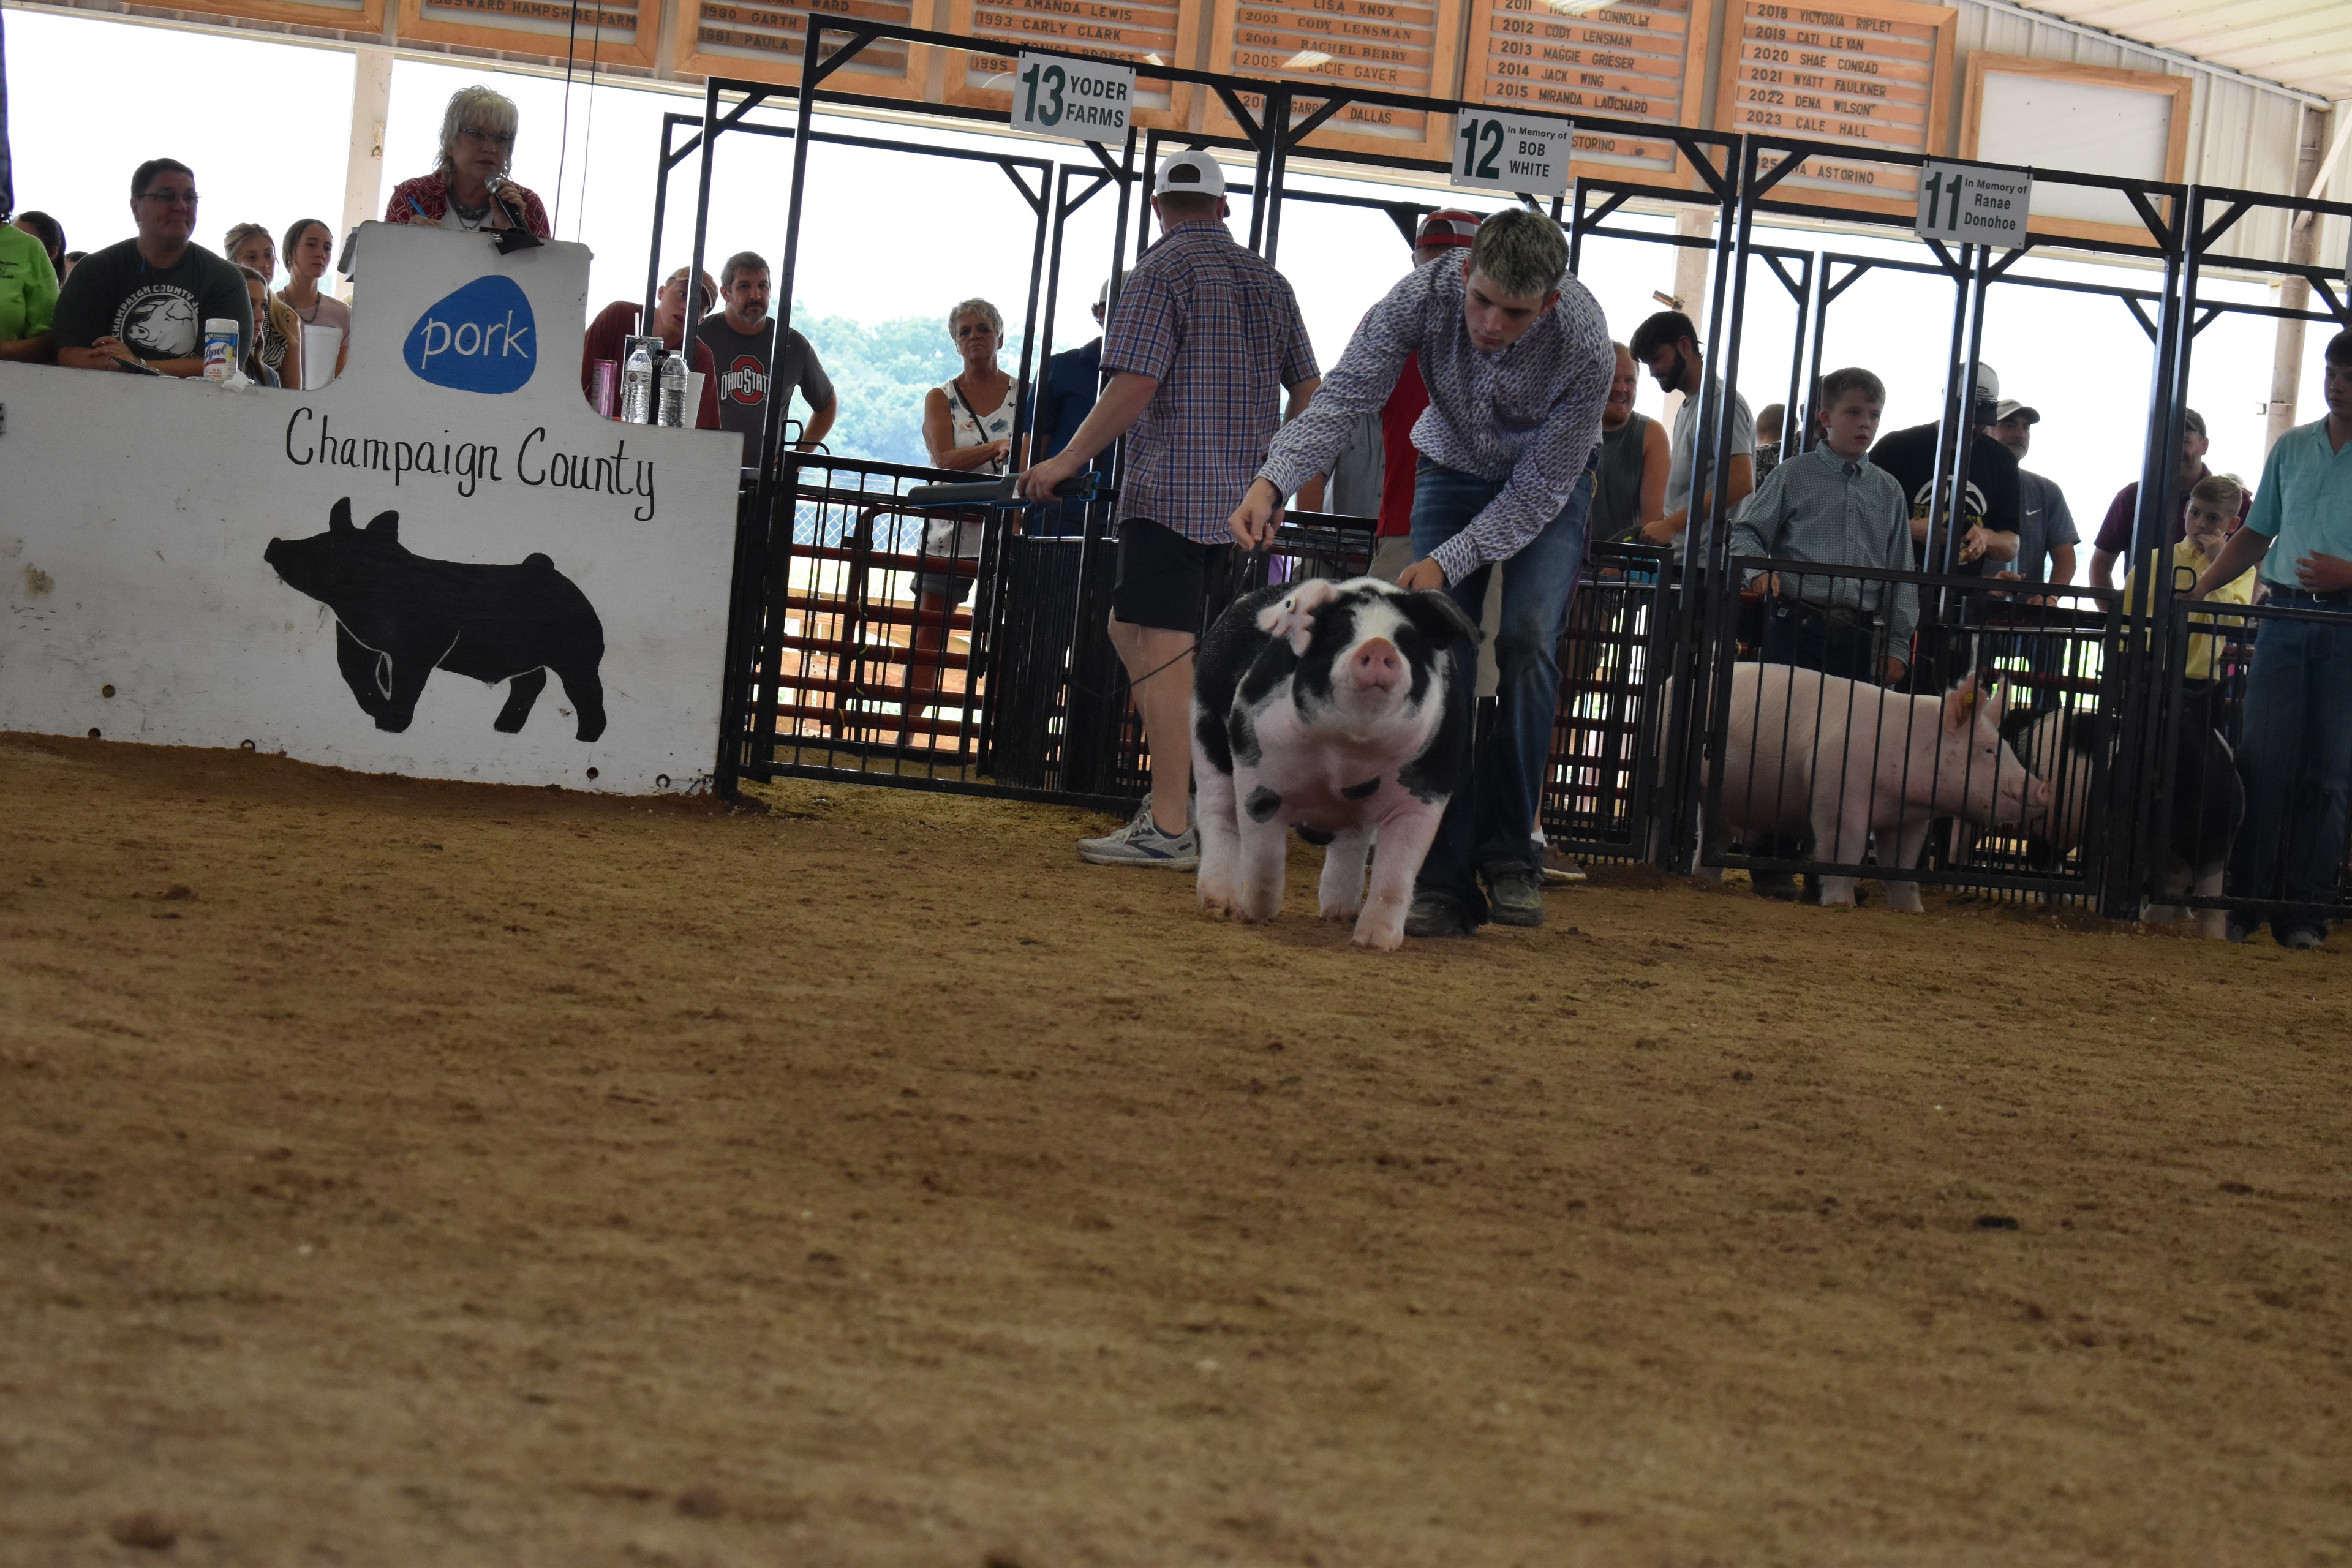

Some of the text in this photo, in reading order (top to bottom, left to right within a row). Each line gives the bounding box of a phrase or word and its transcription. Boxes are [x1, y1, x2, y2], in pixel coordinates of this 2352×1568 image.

[513, 2, 592, 21] HAMPSHRE
[703, 6, 797, 29] 1980 GARTH
[812, 0, 850, 12] WARD
[1024, 0, 1133, 21] AMANDA LEWIS
[1313, 0, 1395, 18] LISA KNOX
[1505, 0, 1531, 11] 2011
[1757, 4, 1893, 33] 2018 VICTORIA RIPLEY
[980, 13, 1121, 41] 1993 CARLY CLARK
[1246, 11, 1412, 40] 2003 CODY LENSMAN
[1502, 19, 1632, 48] 2012 CODY LENSMAN
[1755, 26, 1786, 41] 2019
[1796, 32, 1820, 45] CATI
[701, 29, 789, 50] 1981 PAULA
[1246, 32, 1408, 61] 2004 RACHEL BERRY
[975, 58, 1008, 71] 1995
[1243, 53, 1398, 82] 2005 LACIE GAVER
[1501, 40, 1635, 70] 2013 MAGGIE GRIESER
[1754, 47, 1879, 75] 2020 SHAE CONRAD
[1071, 75, 1128, 102] YODER
[1498, 62, 1604, 88] 2014 JACK WING
[1751, 68, 1887, 97] 2021 WYATT FAULKNER
[1022, 63, 1066, 127] 13
[1497, 83, 1648, 113] 2015 MIRANDA LAUCHARD
[1749, 89, 1871, 116] 2022 DENA WILSON
[1066, 102, 1125, 129] FARMS
[1350, 108, 1392, 124] DALLAS
[1747, 110, 1868, 138] 2023 CALE HALL
[1507, 126, 1516, 134] In
[1519, 127, 1556, 140] Memory
[1572, 136, 1615, 152] STORINO
[1461, 119, 1504, 180] 12
[1518, 141, 1546, 157] BOB
[1510, 160, 1550, 178] WHITE
[1817, 165, 1874, 184] ASTORINO
[1964, 178, 2027, 195] In Memory of
[1925, 172, 1962, 232] 11
[1974, 193, 2011, 210] Ranae
[1964, 211, 2016, 231] Donohoe
[111, 285, 151, 339] CHAMPAIGN
[153, 284, 195, 301] COUNTY
[421, 309, 529, 370] pork
[285, 407, 654, 521] Champaign County
